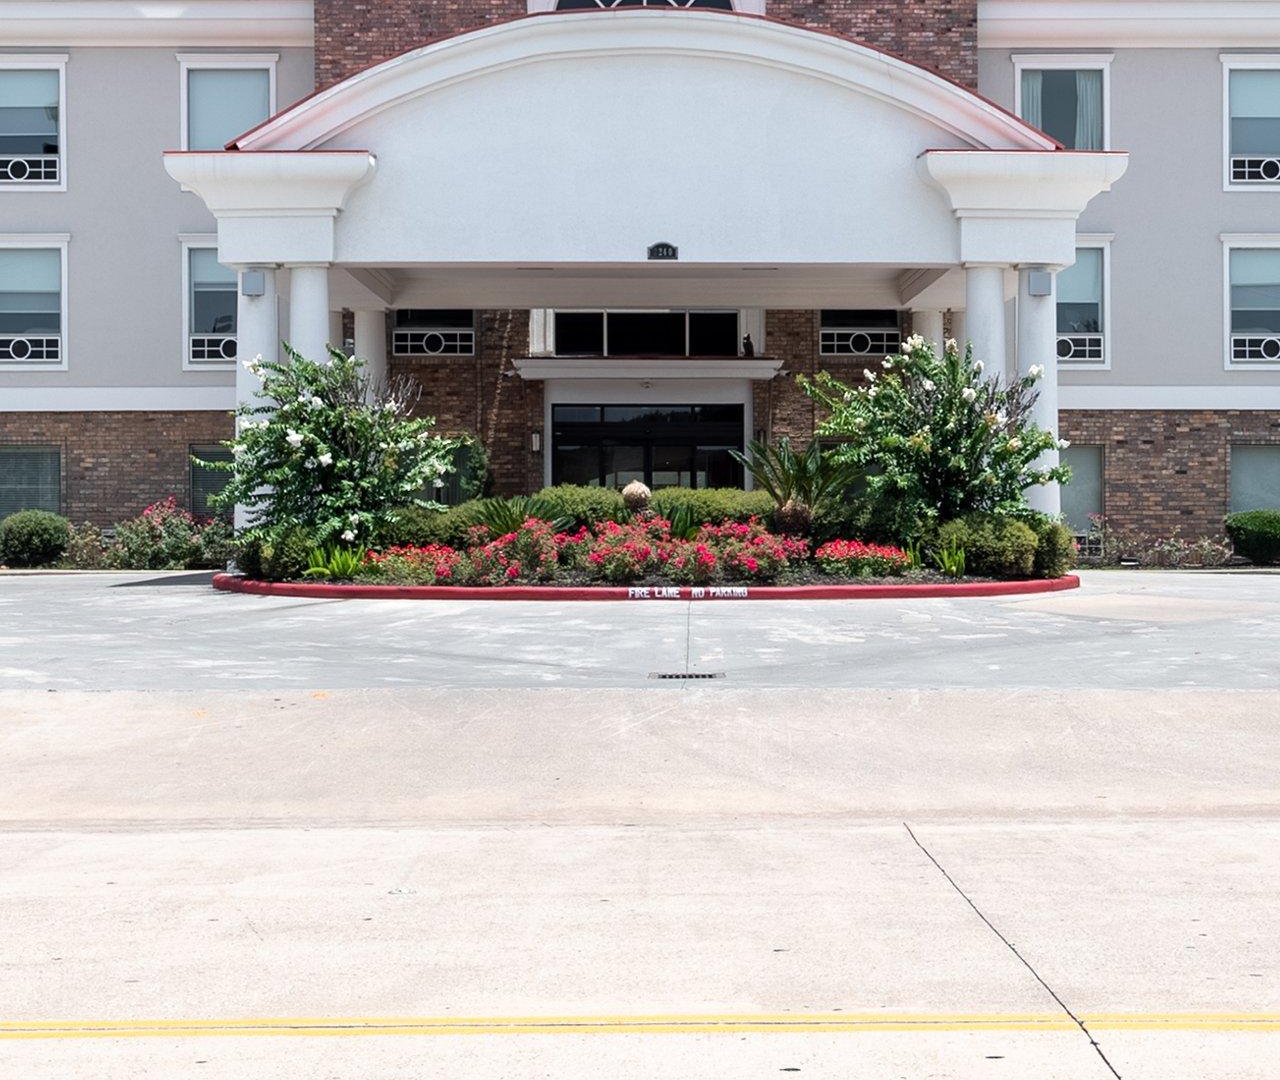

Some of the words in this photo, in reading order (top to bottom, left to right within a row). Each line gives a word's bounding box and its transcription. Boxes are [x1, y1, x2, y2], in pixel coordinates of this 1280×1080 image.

[628, 587, 651, 598] FIRE
[654, 587, 680, 598] LANE
[691, 587, 705, 598] NO
[709, 587, 748, 598] PARKING
